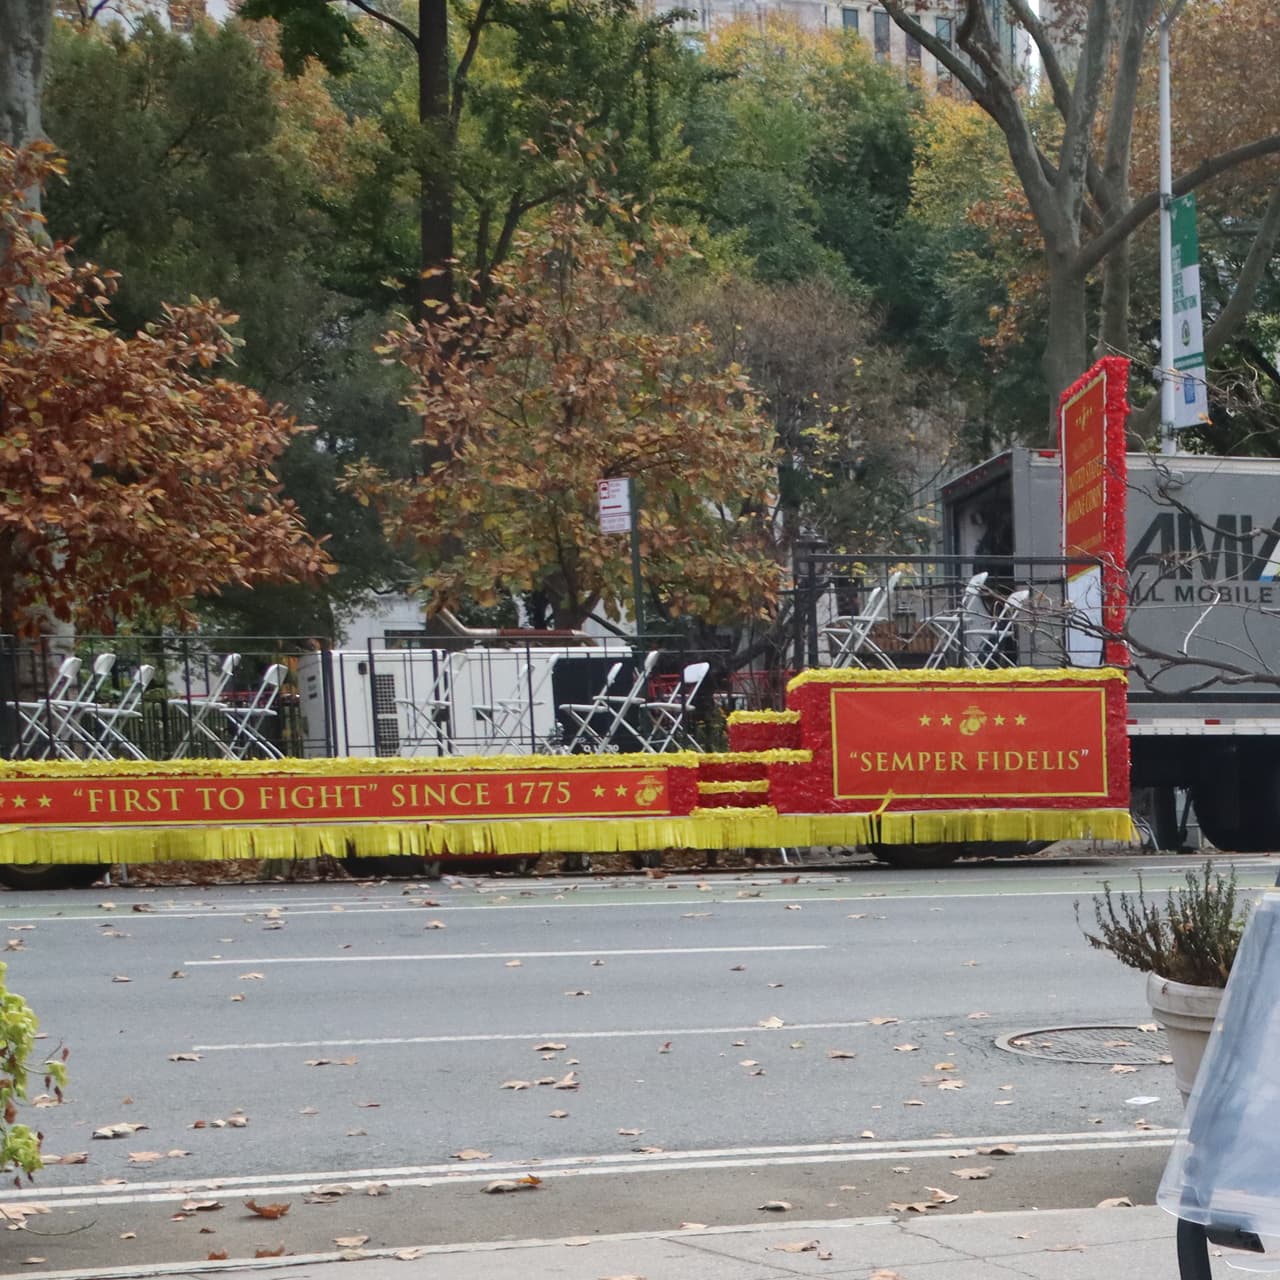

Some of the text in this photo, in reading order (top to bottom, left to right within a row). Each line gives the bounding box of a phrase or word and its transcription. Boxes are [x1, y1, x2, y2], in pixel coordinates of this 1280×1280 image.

[1176, 586, 1272, 604] MOBILE
[196, 787, 245, 810] TO
[392, 783, 491, 807] SINCE
[504, 781, 571, 805] 1775
